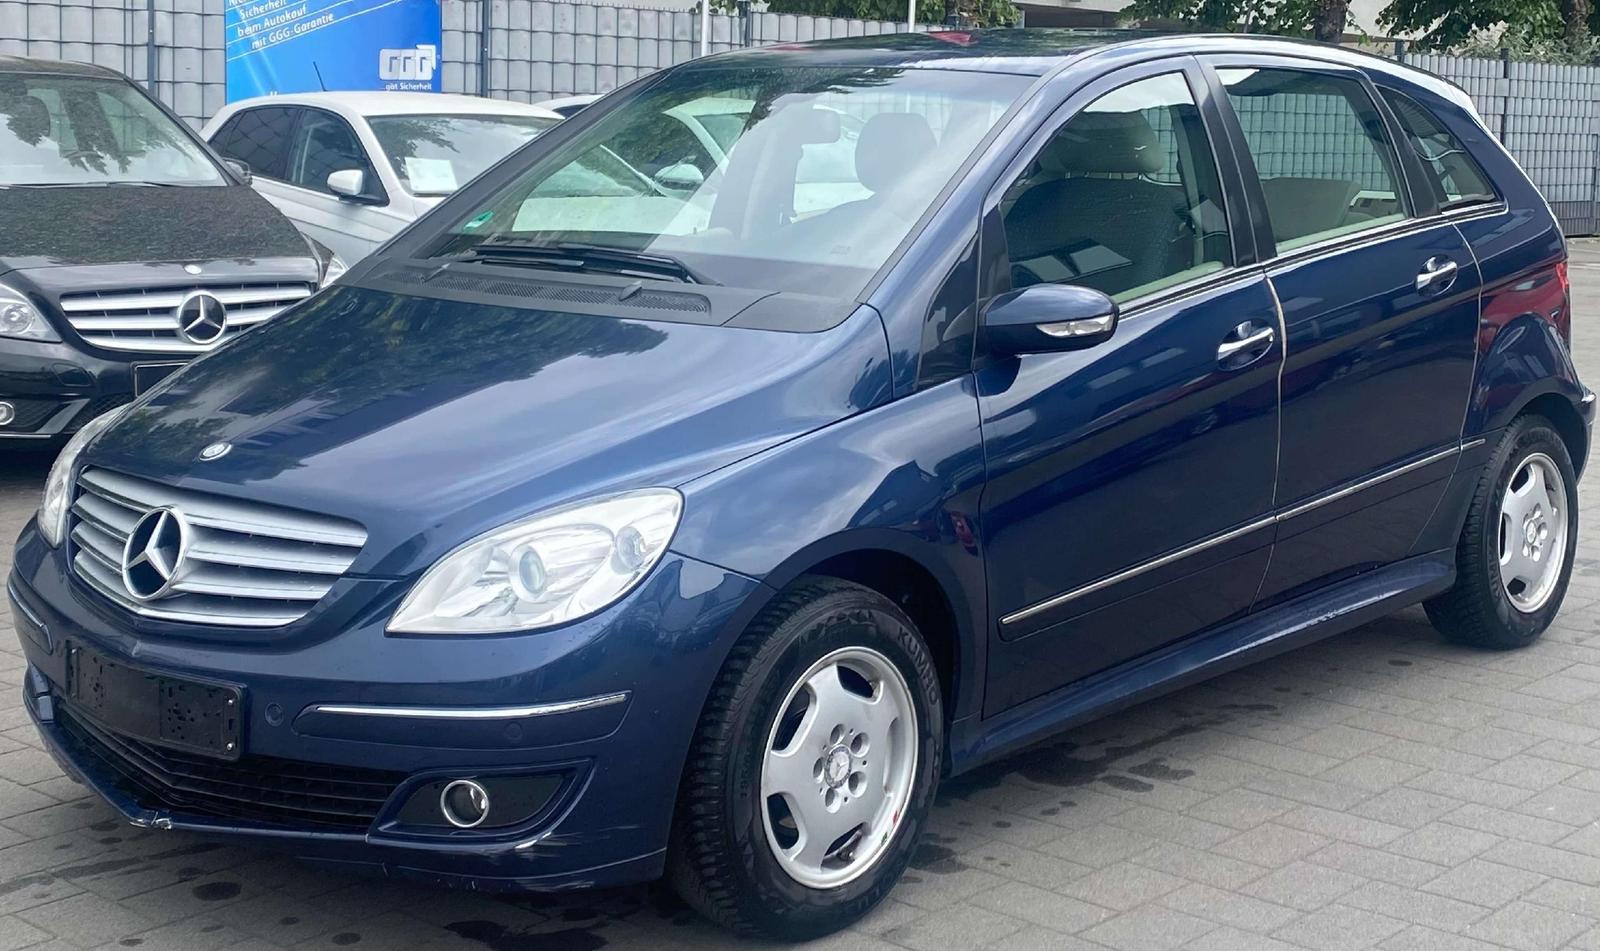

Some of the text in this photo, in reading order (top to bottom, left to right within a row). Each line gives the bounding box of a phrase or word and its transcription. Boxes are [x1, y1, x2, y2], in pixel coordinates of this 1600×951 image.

[237, 4, 306, 38] beim Autokauf
[240, 0, 287, 20] Sicherheit
[252, 13, 334, 49] mit GGG-Garantie
[897, 624, 938, 705] KUMHO
